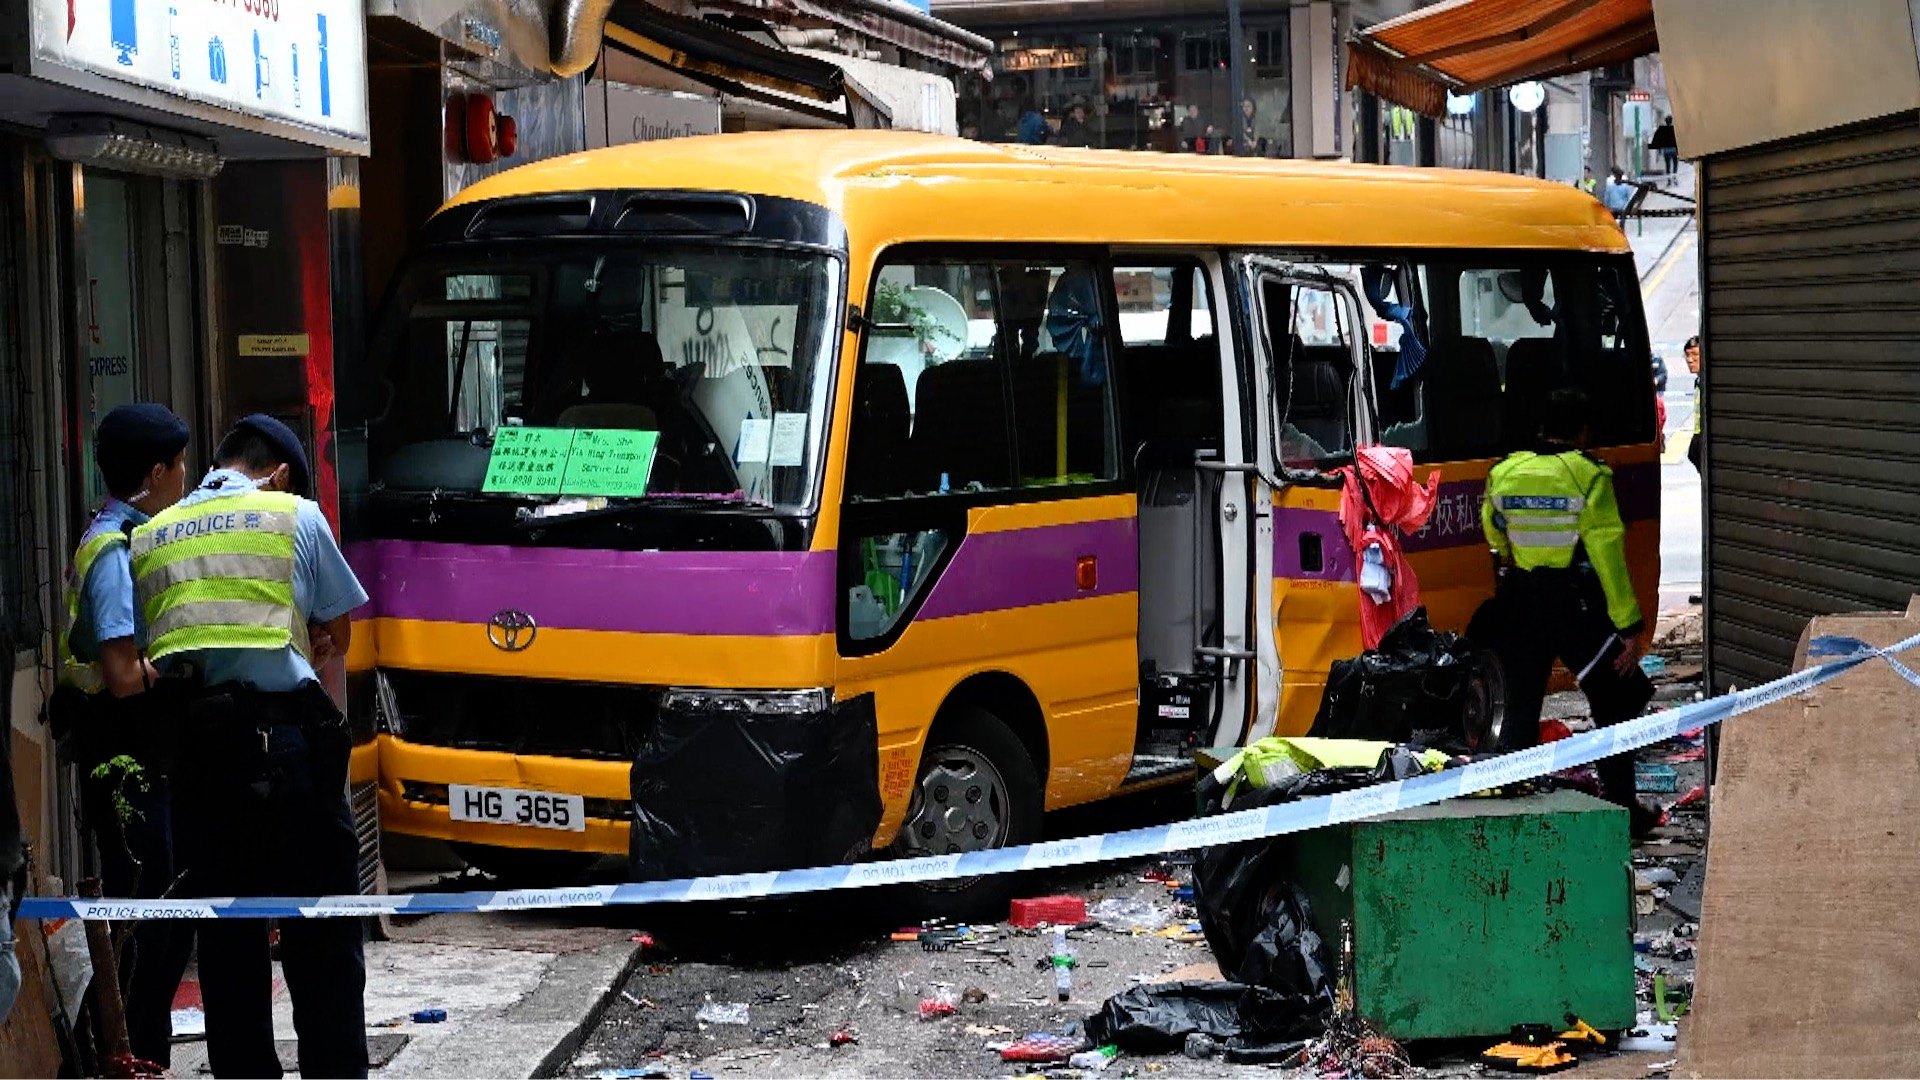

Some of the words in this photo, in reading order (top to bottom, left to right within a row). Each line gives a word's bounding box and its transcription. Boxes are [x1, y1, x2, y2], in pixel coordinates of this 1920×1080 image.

[89, 356, 127, 376] EXPRESS
[174, 513, 236, 538] POLICE
[464, 790, 503, 818] HG
[515, 793, 570, 826] 365
[86, 907, 138, 918] POLICE
[142, 908, 205, 919] CORDON
